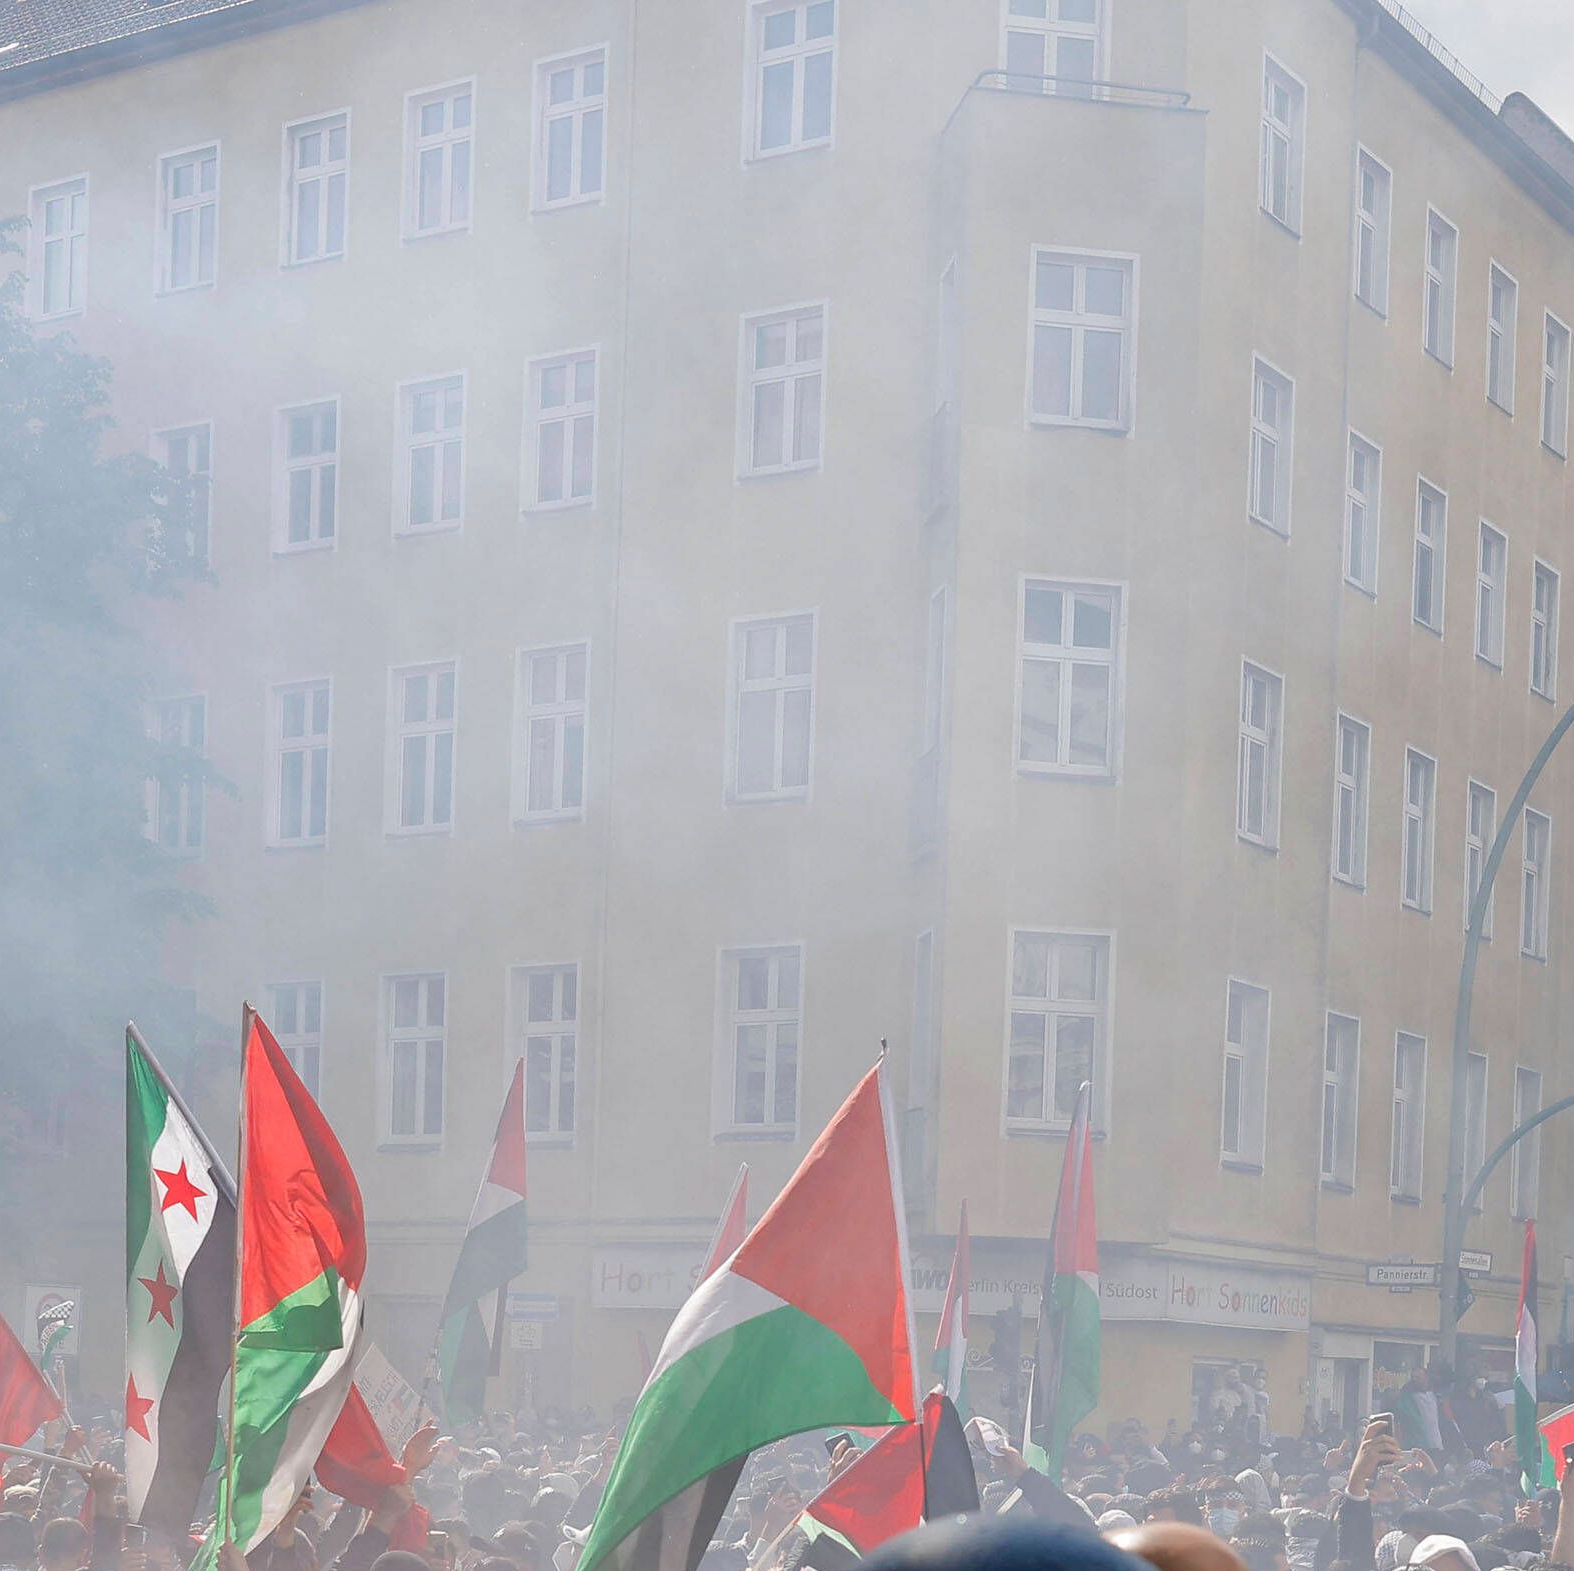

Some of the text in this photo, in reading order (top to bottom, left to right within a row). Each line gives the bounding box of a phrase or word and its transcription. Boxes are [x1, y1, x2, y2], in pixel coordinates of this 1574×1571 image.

[968, 1278, 999, 1293] erlin
[1106, 1281, 1161, 1299] Südost
[1217, 1281, 1307, 1319] Sonnenkids
